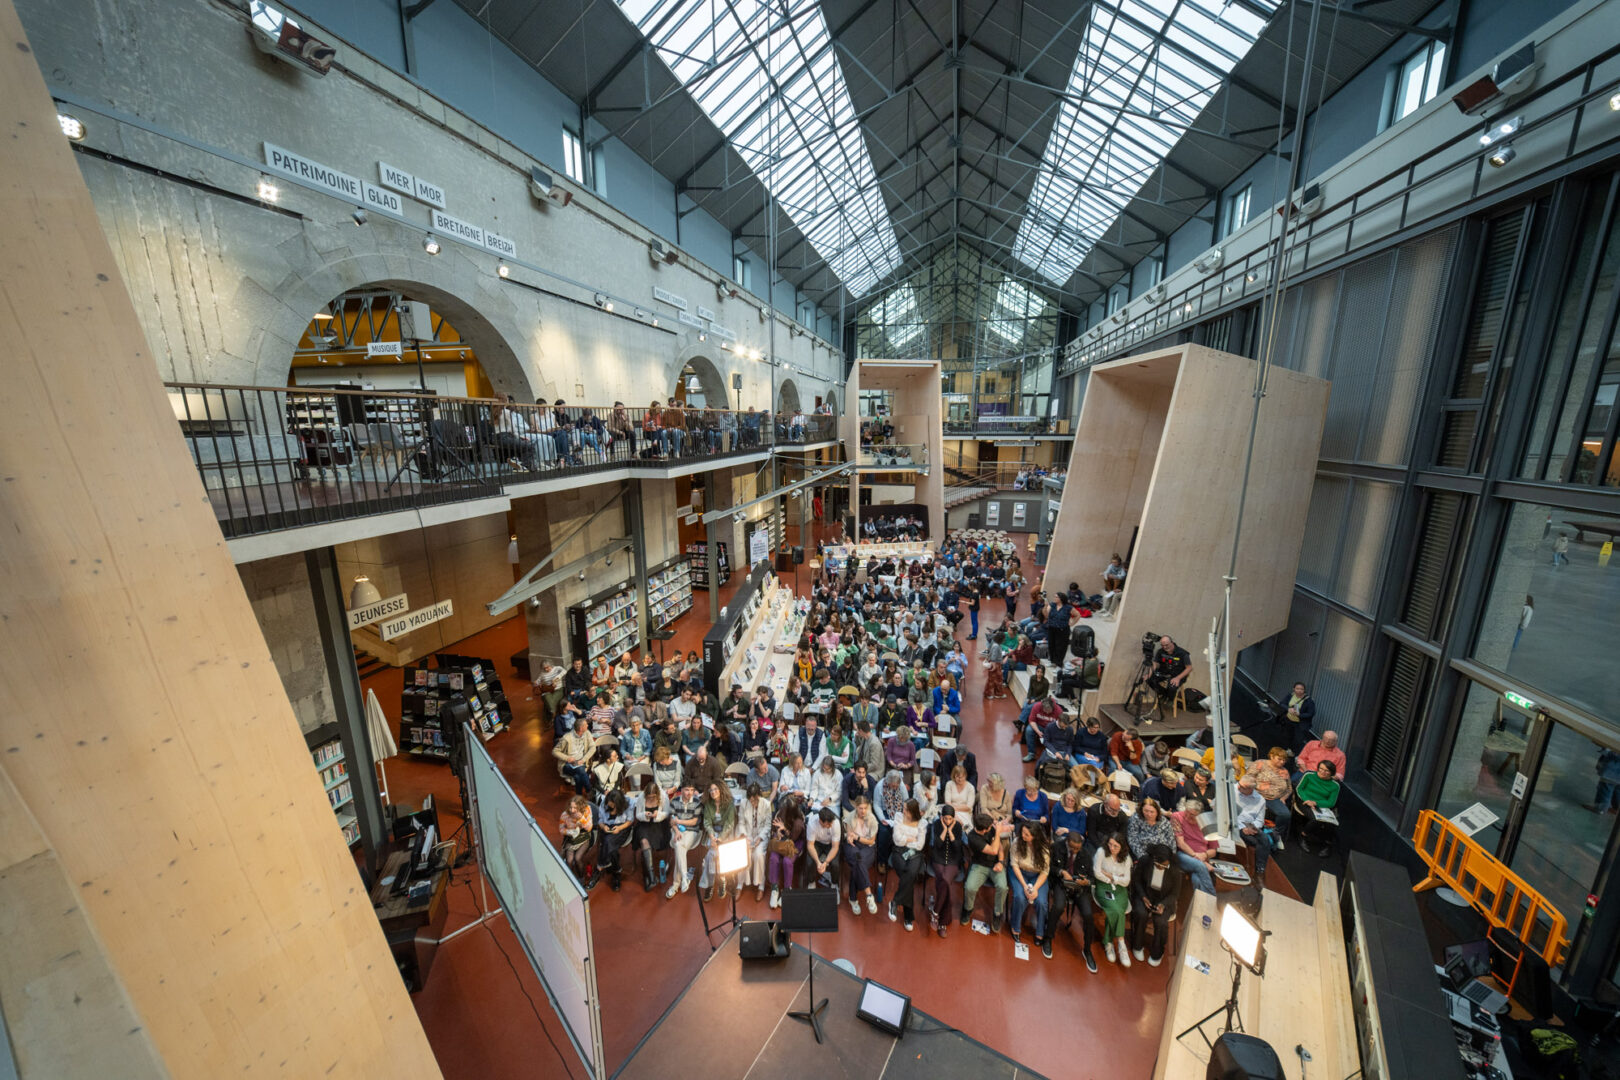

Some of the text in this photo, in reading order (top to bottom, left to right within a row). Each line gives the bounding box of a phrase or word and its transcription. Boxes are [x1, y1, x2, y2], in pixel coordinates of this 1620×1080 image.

[272, 150, 398, 210] PATRIMOINE GLAD
[386, 169, 442, 203] MER MOR
[437, 215, 514, 254] BRETAGNE BREIZH
[371, 344, 398, 353] MUSIQUE
[353, 598, 405, 625] JEUNESSE
[386, 604, 450, 636] TUD YAOUANK
